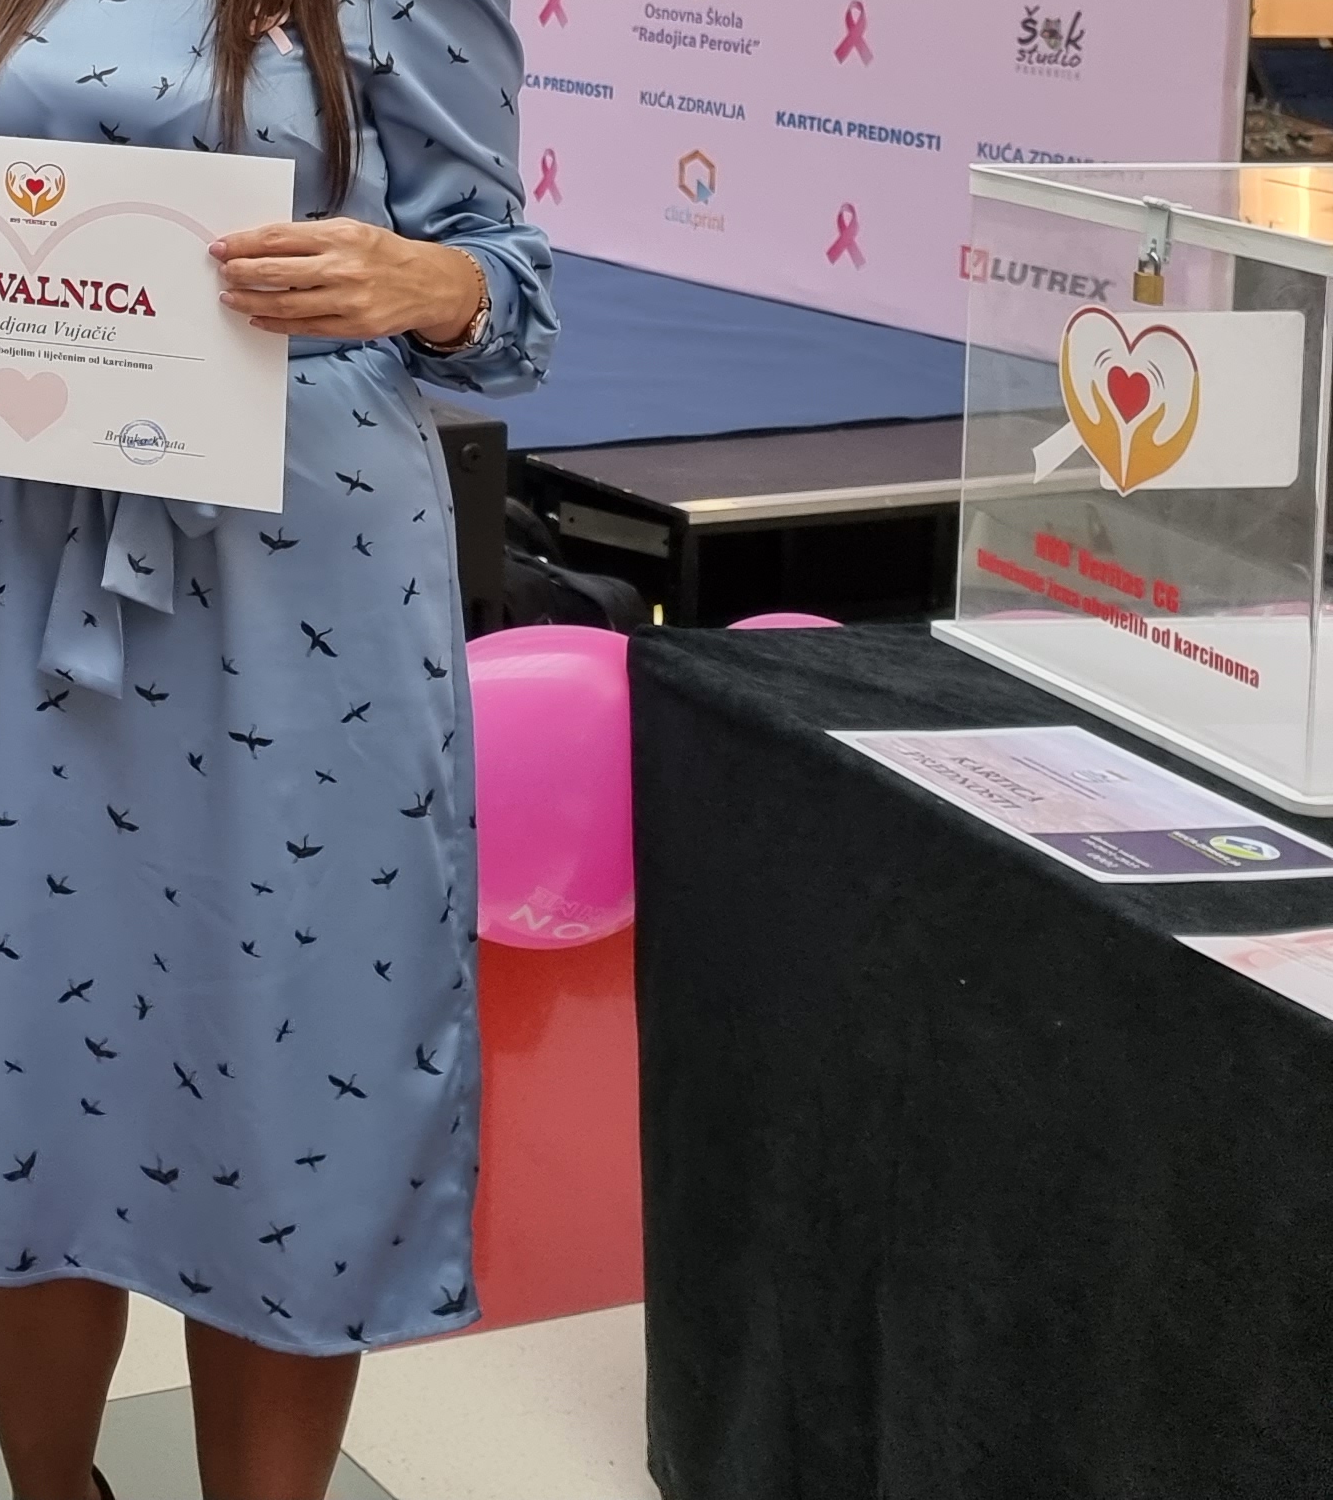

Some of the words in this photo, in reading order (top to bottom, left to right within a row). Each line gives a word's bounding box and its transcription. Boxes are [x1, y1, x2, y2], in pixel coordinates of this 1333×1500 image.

[645, 3, 702, 25] Osnovna
[705, 7, 743, 29] Škola
[543, 75, 613, 100] PREDNOSTI
[639, 90, 675, 110] KUĆA
[677, 97, 745, 121] ZDRAVLJA
[776, 110, 843, 137] KARTICA
[846, 121, 941, 151] PREDNOSTI
[977, 141, 1024, 164] KUĆA
[990, 257, 1112, 302] LUTREX
[53, 321, 117, 342] Vujačić
[88, 355, 100, 364] od
[103, 357, 153, 370] karcinoma
[1152, 579, 1179, 613] CG
[1152, 626, 1171, 650] od
[1174, 631, 1260, 690] karcinoma
